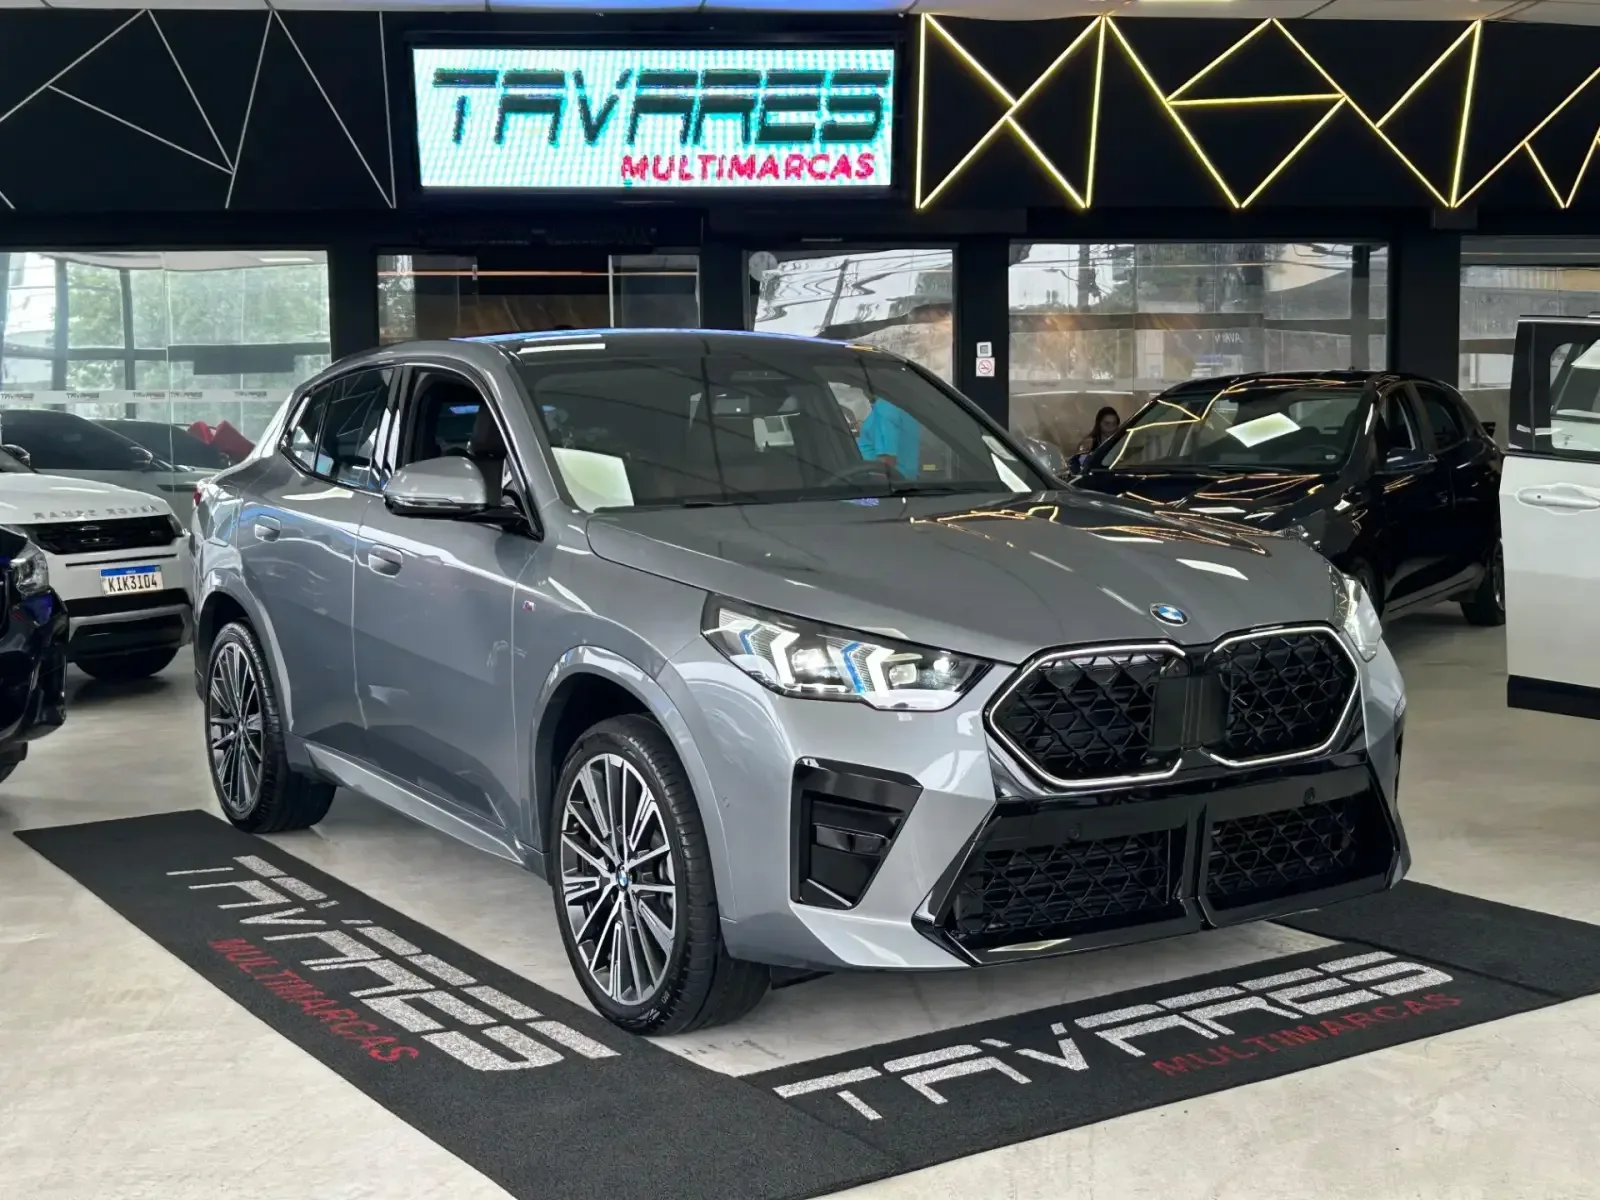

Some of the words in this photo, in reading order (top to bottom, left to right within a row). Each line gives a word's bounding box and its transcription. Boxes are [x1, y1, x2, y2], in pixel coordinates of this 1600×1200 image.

[432, 69, 891, 144] TAVARES
[621, 153, 876, 181] MULTIMARCAS
[166, 855, 622, 1072] TAVARES
[209, 937, 420, 1064] MULTIMARCAS
[773, 951, 1454, 1121] TAVARES
[1151, 993, 1462, 1075] MULTIMARCAS
